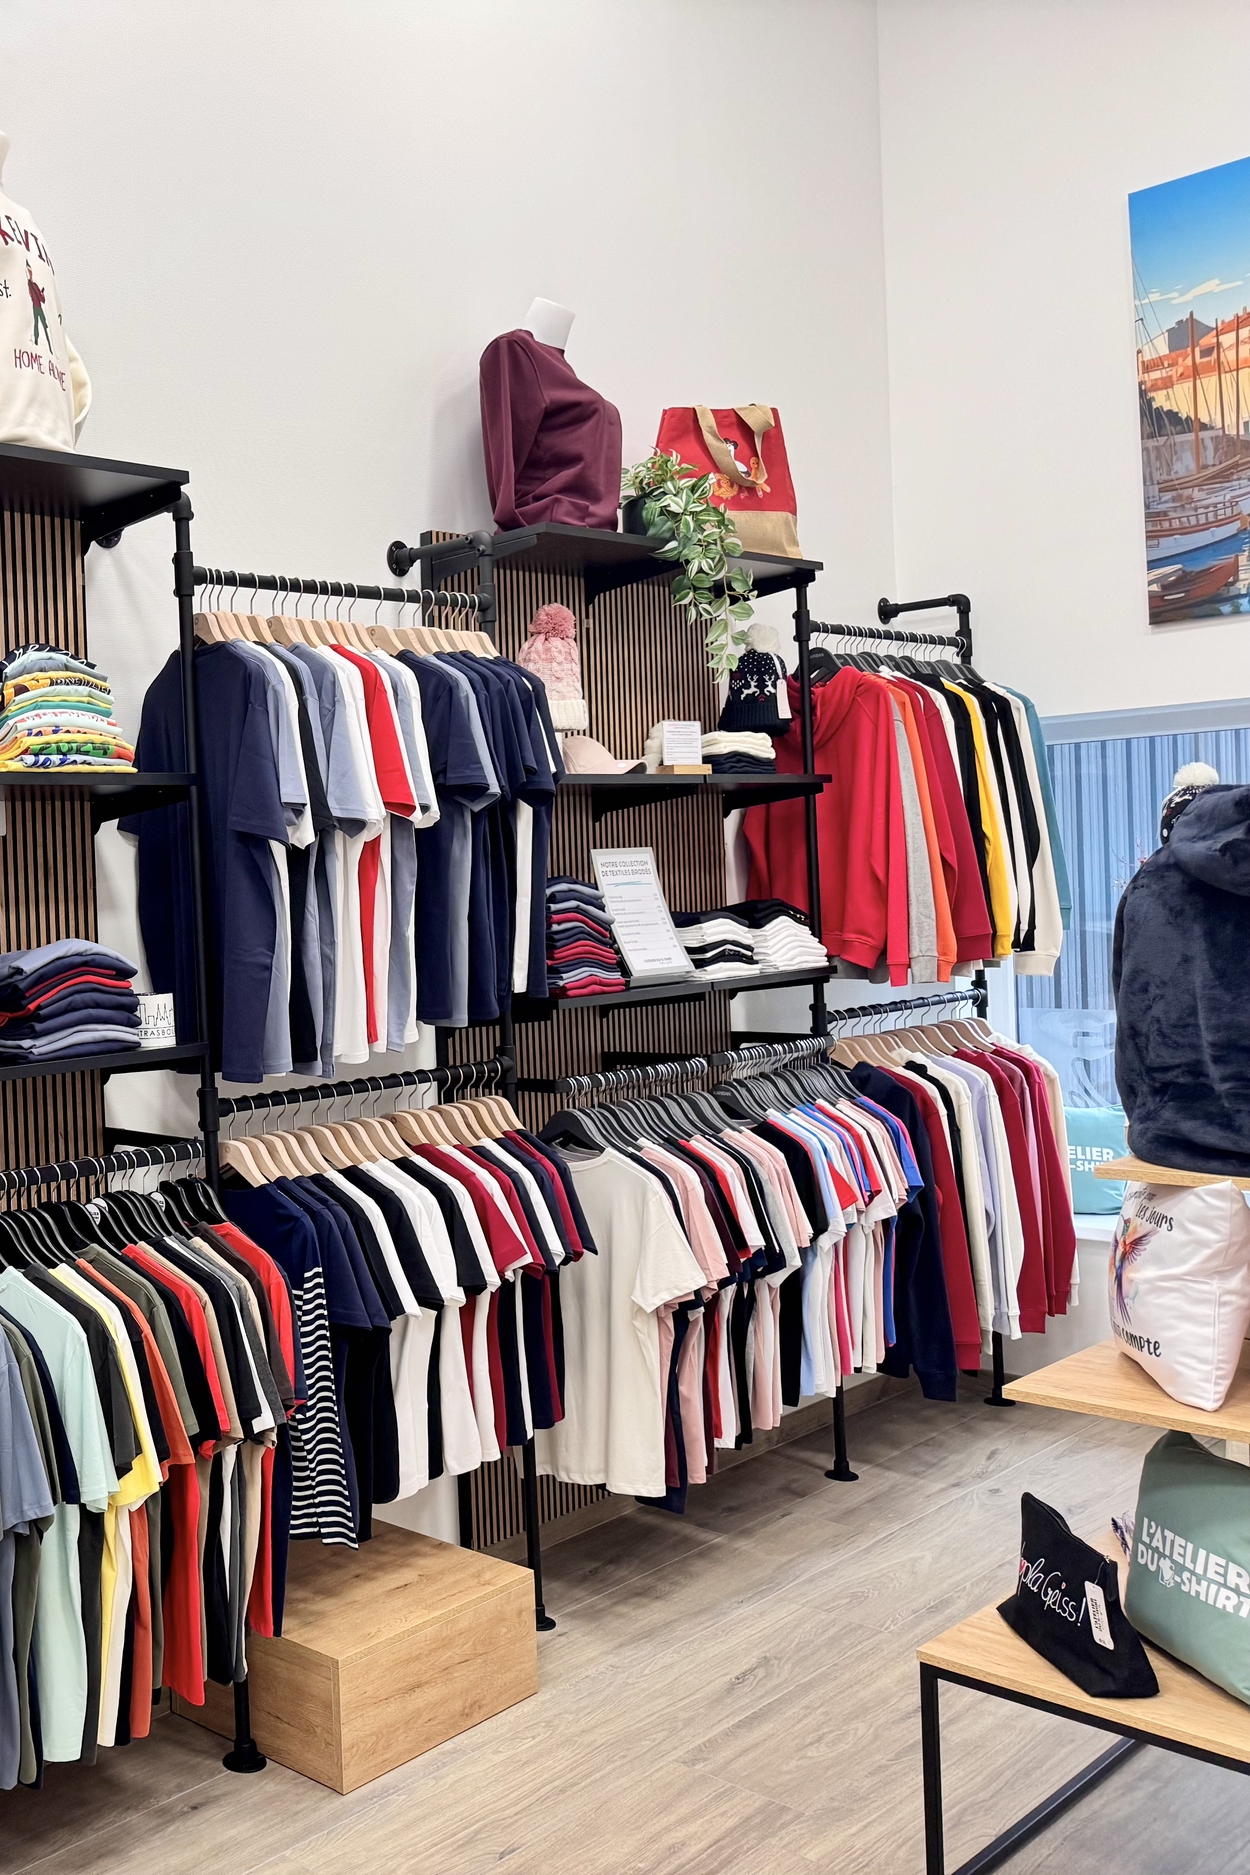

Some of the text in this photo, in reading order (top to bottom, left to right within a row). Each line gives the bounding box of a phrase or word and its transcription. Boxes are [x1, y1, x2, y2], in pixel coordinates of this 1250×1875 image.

[13, 348, 45, 375] HOME
[600, 860, 649, 869] NOTRE COLLECTION
[609, 869, 631, 877] TEXTILES
[137, 1029, 175, 1037] TRASBO
[1146, 1206, 1175, 1232] jours
[1137, 1542, 1158, 1572] DU
[1141, 1516, 1250, 1595] L'ATELIER
